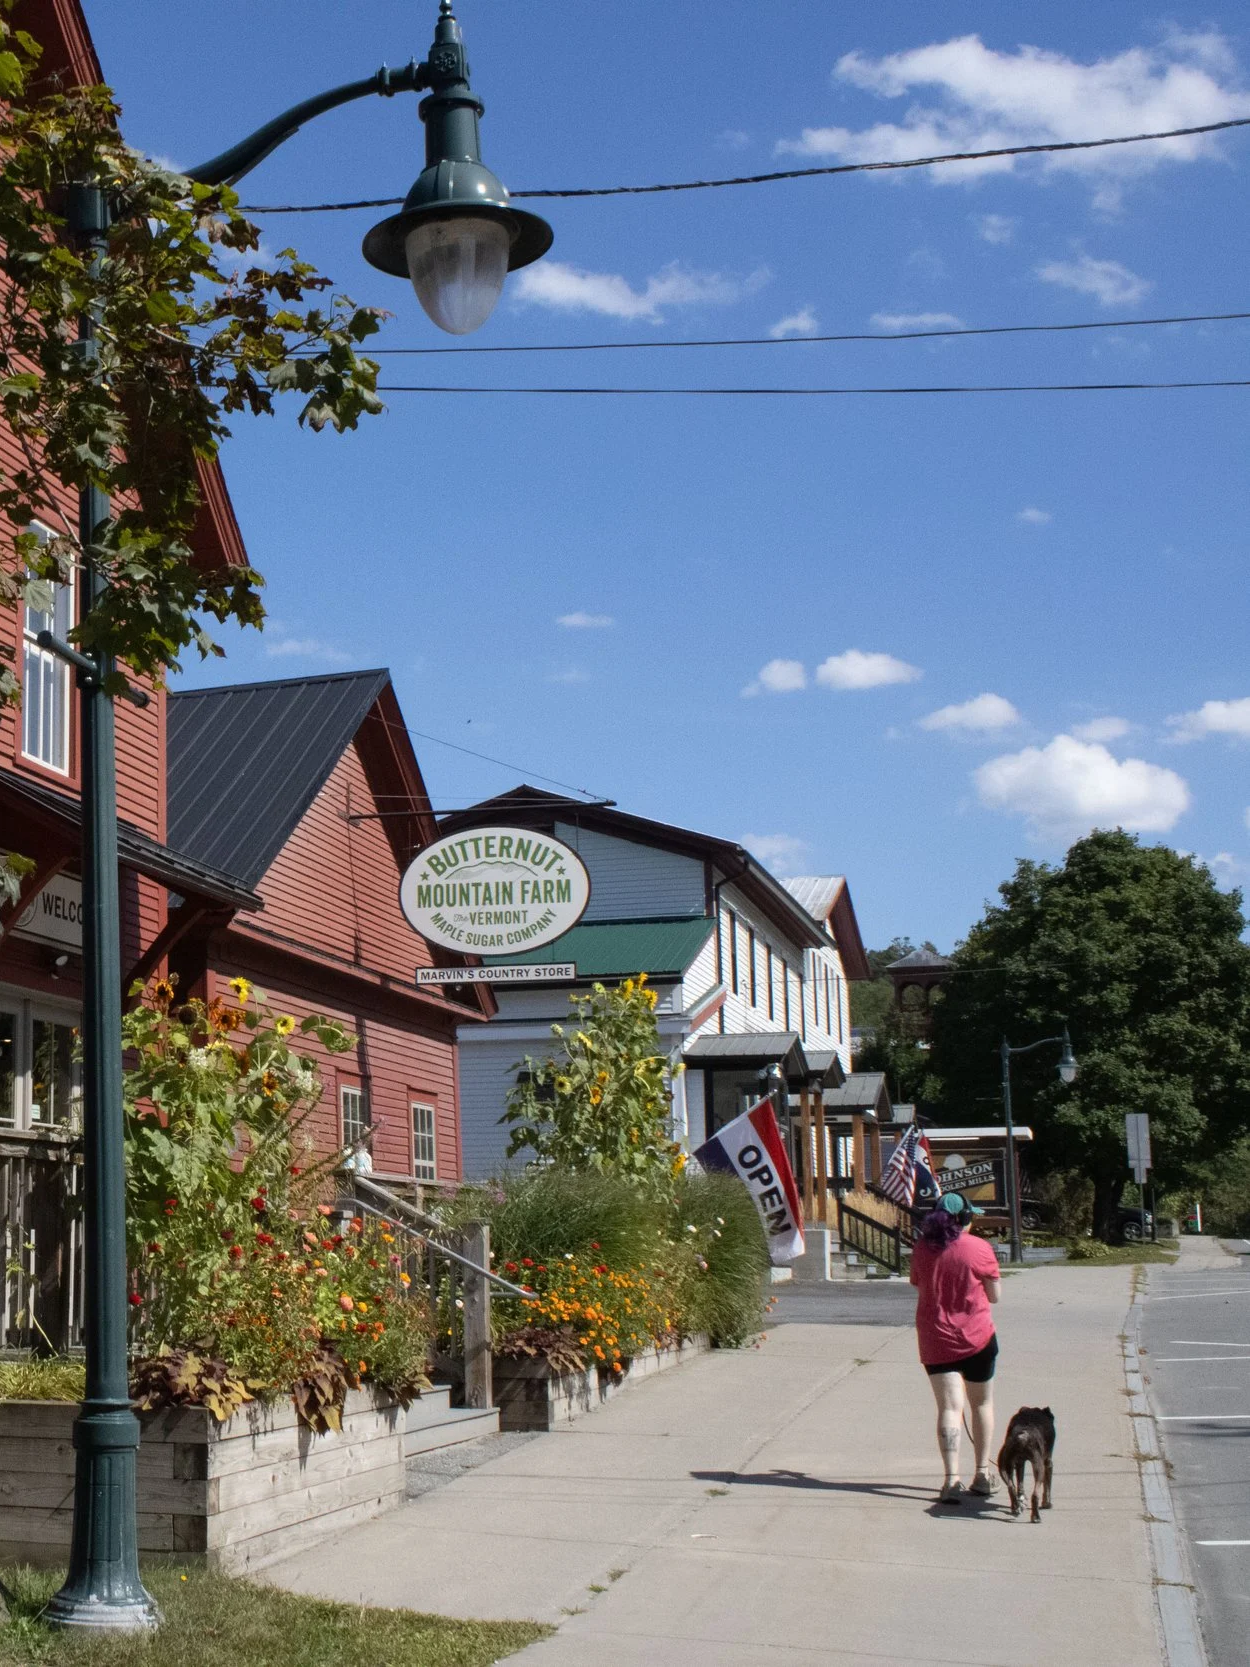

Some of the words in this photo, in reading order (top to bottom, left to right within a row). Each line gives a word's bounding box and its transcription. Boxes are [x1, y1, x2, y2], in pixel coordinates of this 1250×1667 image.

[426, 835, 565, 877] BUTTERNUT
[42, 891, 83, 925] WELCO
[416, 881, 514, 909] MOUNTAIN
[520, 878, 572, 905] FARM
[430, 912, 465, 943] MAPLE
[465, 931, 505, 947] SUGAR
[506, 908, 558, 945] COMPANY
[469, 910, 529, 926] VERMONT
[420, 969, 475, 981] MARVIN'S
[478, 968, 531, 979] COUNTRY
[534, 966, 572, 977] STORE
[738, 1144, 792, 1236] OPEN
[941, 1181, 967, 1192] OOLEN
[968, 1175, 995, 1186] MILLS
